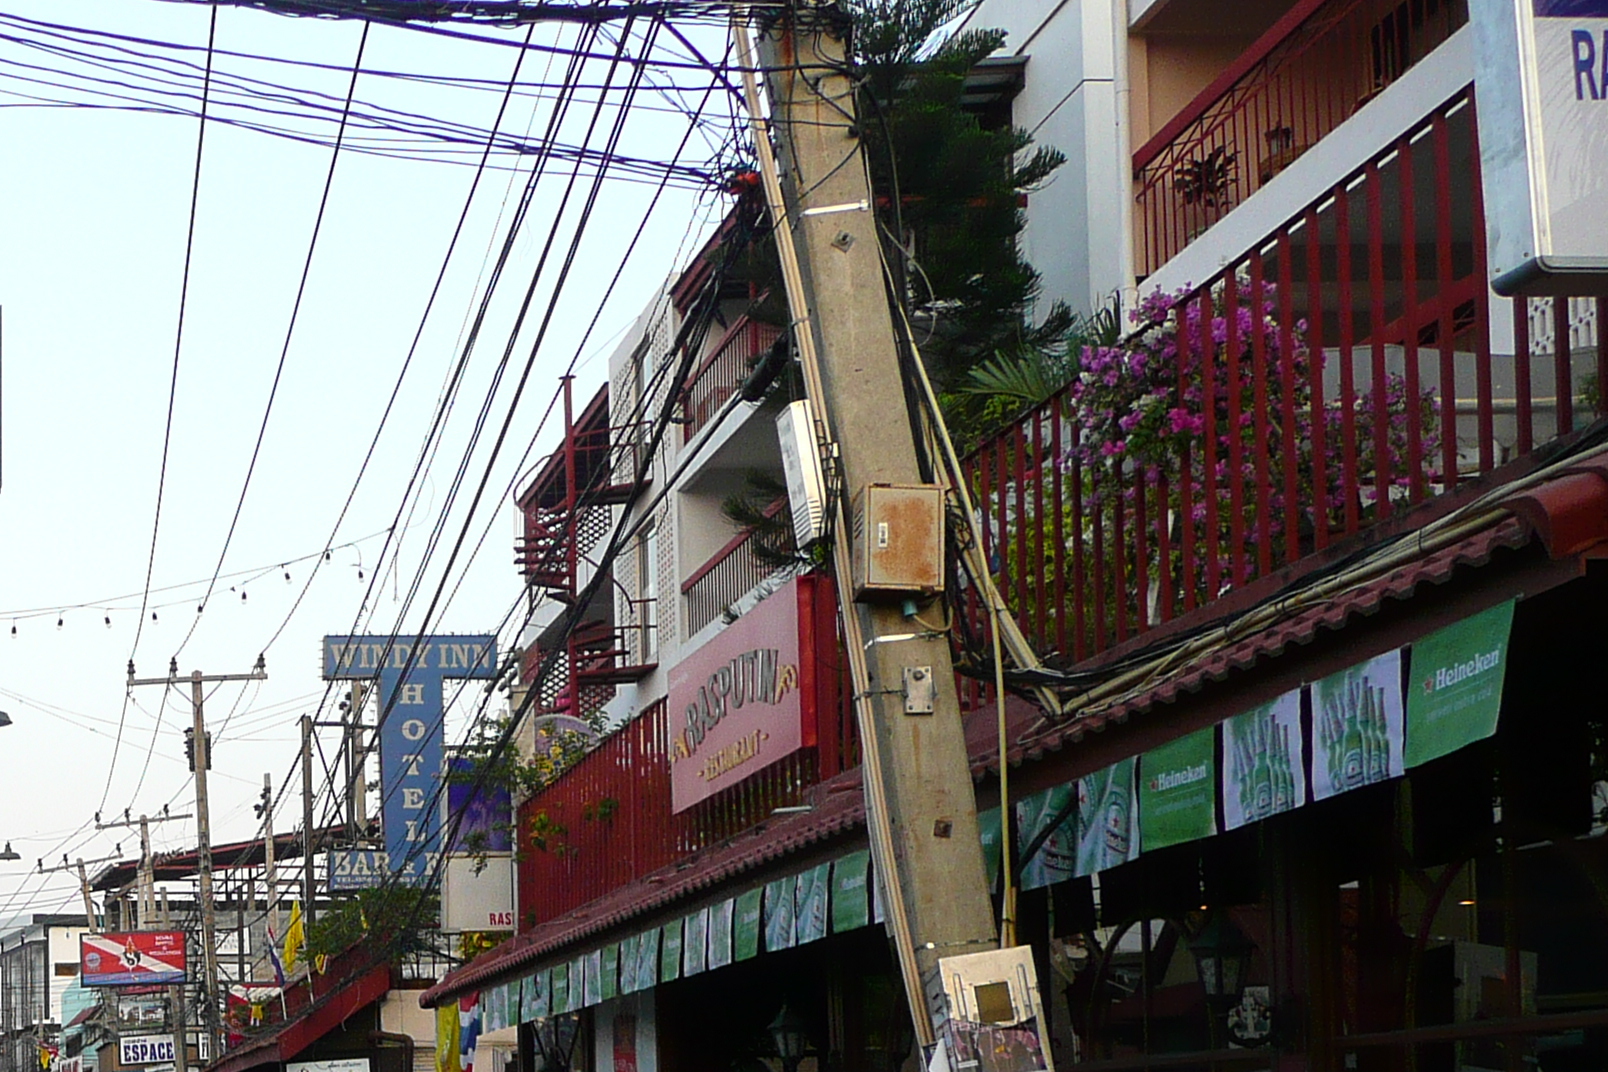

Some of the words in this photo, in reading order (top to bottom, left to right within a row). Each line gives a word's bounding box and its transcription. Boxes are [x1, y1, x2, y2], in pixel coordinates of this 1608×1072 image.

[330, 643, 434, 668] WINDY
[438, 644, 490, 668] INN
[1435, 650, 1499, 690] Heineken
[685, 648, 779, 754] RASPUTIN
[400, 684, 426, 842] HOTEL
[704, 728, 762, 783] RESTAURANT
[1157, 765, 1207, 791] Heineken
[334, 851, 392, 875] BAR
[489, 912, 513, 926] RAS
[123, 1042, 173, 1062] ESPACE
